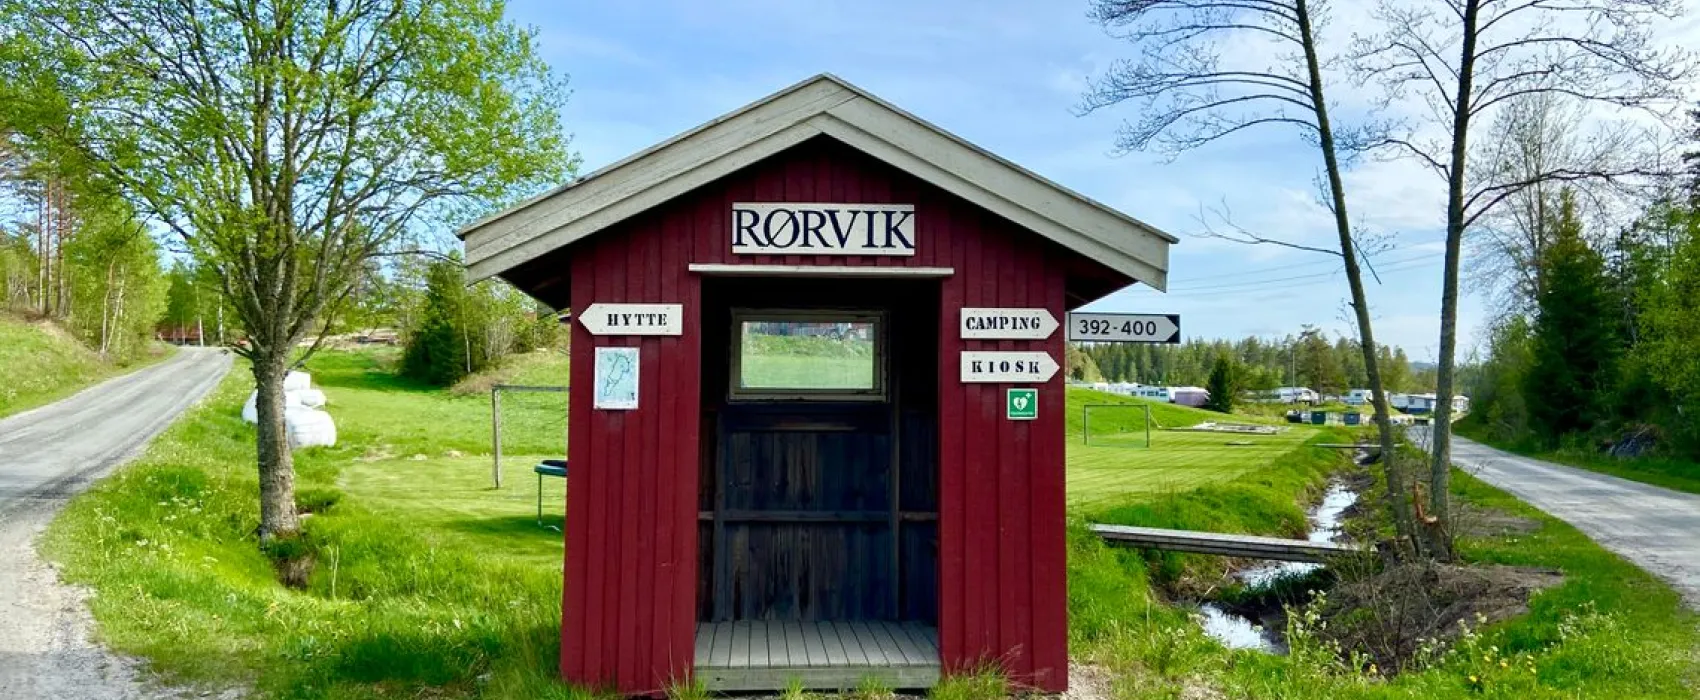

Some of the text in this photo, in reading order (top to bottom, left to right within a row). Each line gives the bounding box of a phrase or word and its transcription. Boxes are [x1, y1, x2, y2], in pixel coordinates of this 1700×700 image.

[732, 208, 915, 248] RØRVIK
[607, 313, 668, 327] HYTTE
[965, 316, 1041, 330] CAMPING
[1079, 319, 1157, 336] 392-400
[971, 360, 1040, 374] KIOSK
